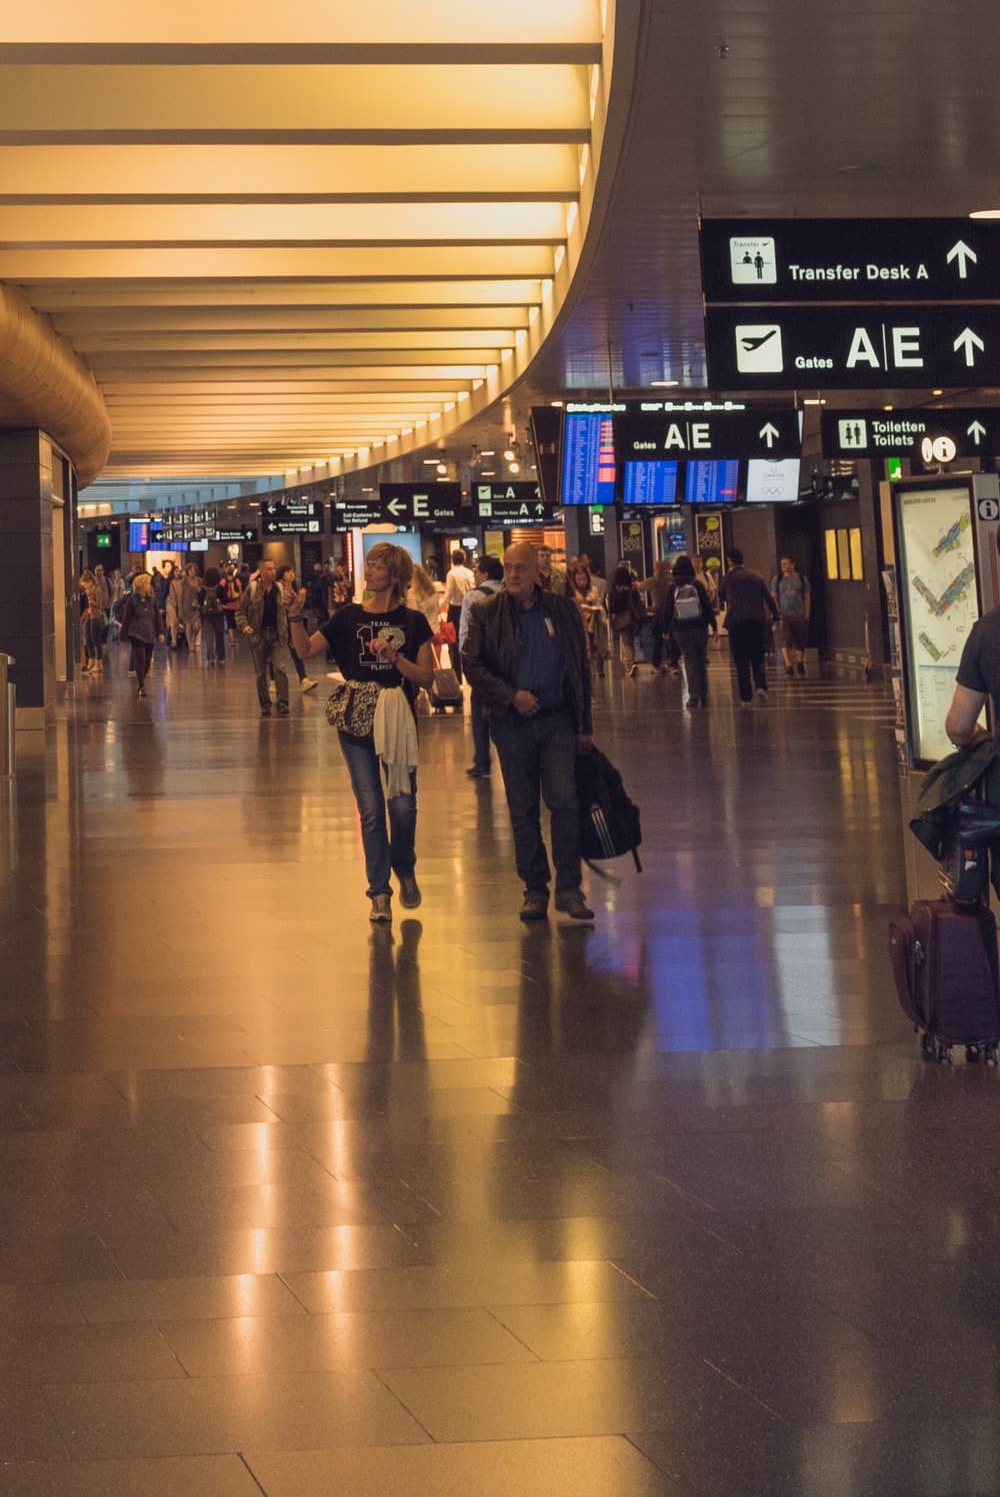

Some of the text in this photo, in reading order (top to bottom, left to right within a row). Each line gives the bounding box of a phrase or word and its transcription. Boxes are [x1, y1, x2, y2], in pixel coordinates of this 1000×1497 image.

[789, 264, 928, 280] Transfer Desk A
[795, 327, 924, 369] Gates A E
[872, 421, 926, 433] Toiletten
[633, 423, 712, 450] Gates A E
[873, 434, 914, 446] Toilets
[505, 486, 516, 499] A
[413, 494, 454, 517] E Gates
[519, 503, 529, 515] A
